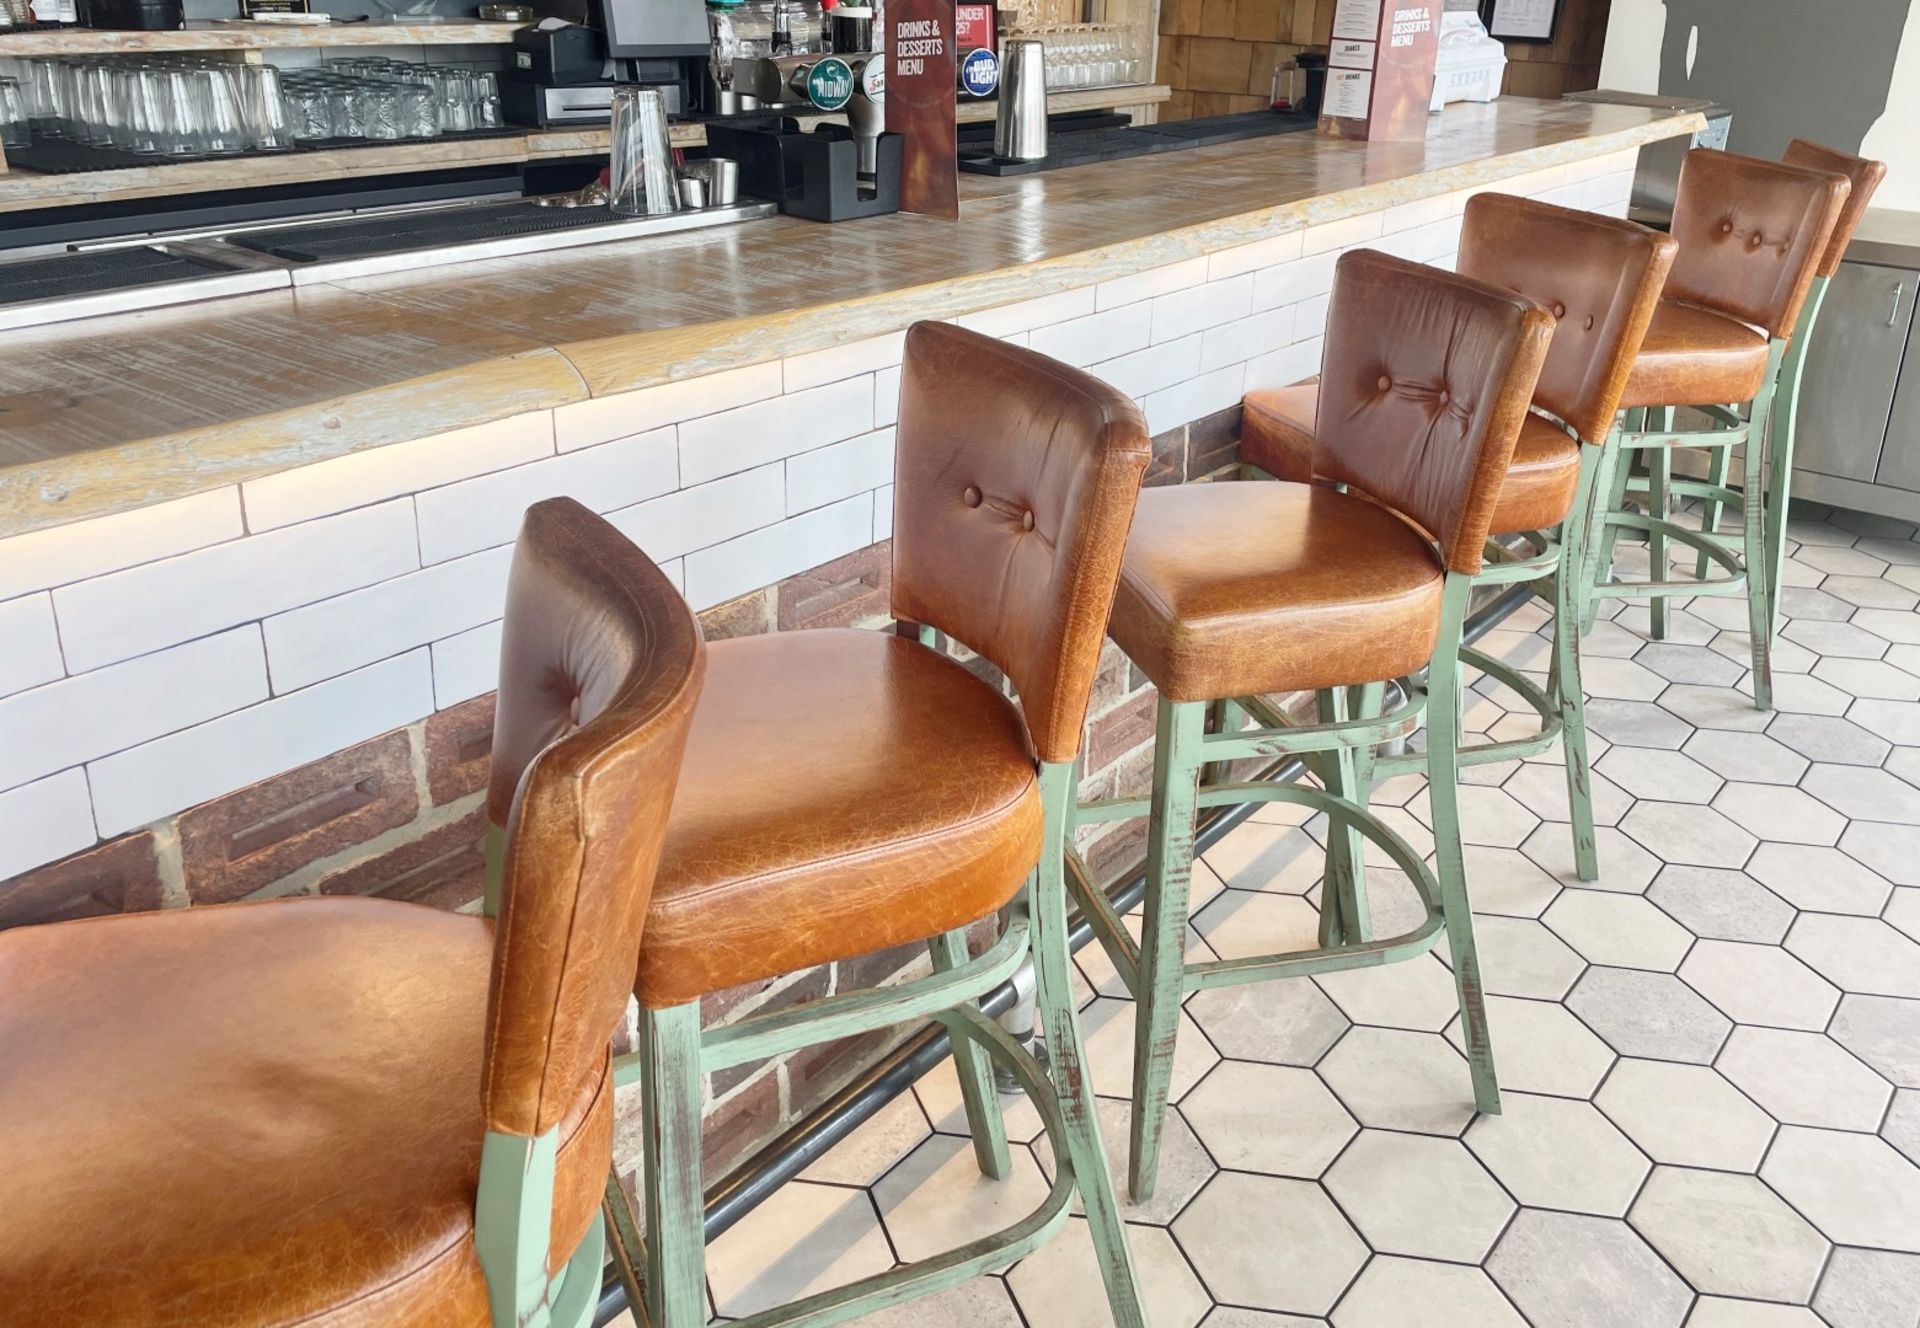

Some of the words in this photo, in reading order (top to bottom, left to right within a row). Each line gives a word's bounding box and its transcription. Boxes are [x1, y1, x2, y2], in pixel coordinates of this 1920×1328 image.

[956, 8, 984, 20] UNDER
[1394, 8, 1422, 21] DRINKS
[1423, 6, 1430, 19] &
[897, 20, 931, 38] DRINKS
[931, 19, 941, 36] &
[1392, 20, 1431, 34] DESSERTS
[897, 38, 943, 57] DESSERTS
[1391, 34, 1414, 48] MENU
[897, 58, 924, 76] MENU
[973, 59, 995, 72] BUD
[813, 75, 851, 98] MIDWAY
